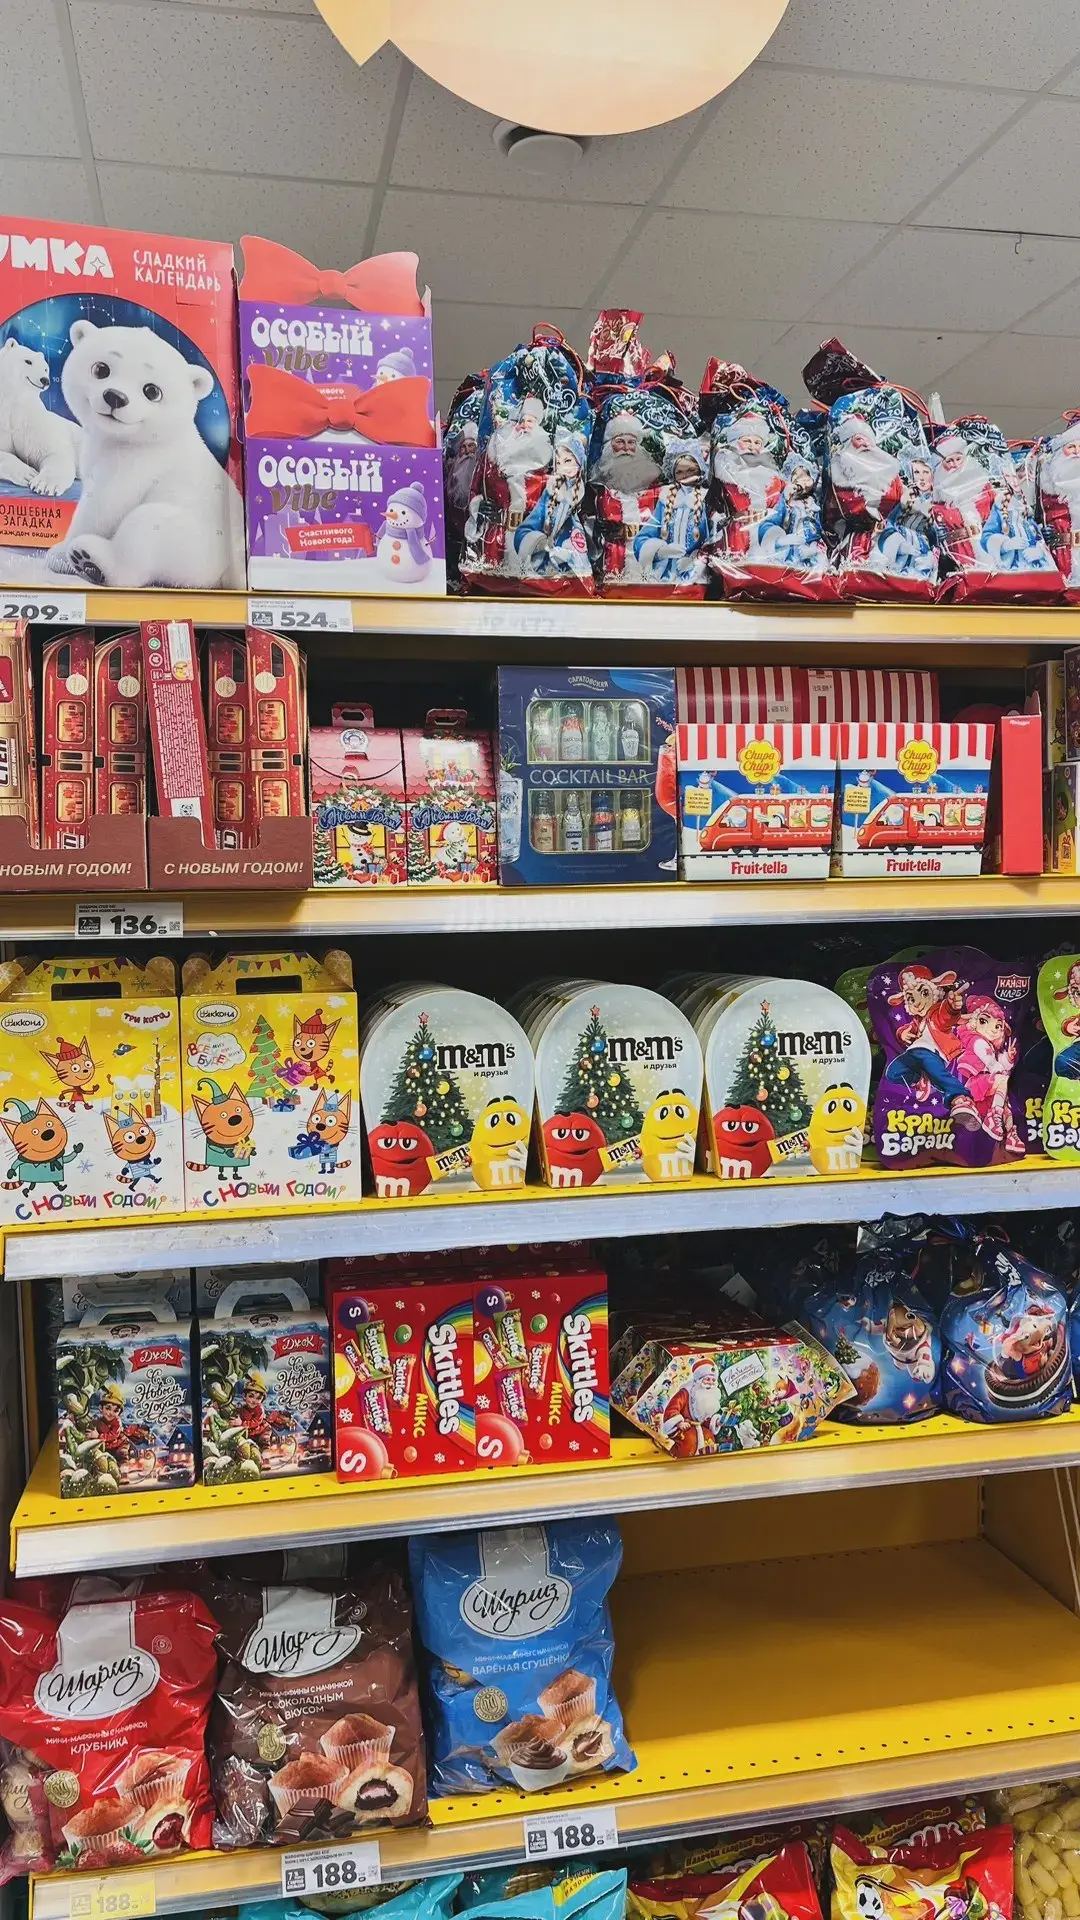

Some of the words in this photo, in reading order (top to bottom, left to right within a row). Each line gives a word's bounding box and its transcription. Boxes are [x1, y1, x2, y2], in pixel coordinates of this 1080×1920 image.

[133, 249, 207, 273] СЛАДКИЙ
[134, 267, 221, 292] КАЛЕНДАРЬ
[251, 316, 374, 357] ОСОБЫЙ
[258, 452, 383, 493] ОСОБЫЙ
[269, 483, 339, 513] Vibe
[0, 504, 62, 519] ОЛШЕБНАЯ
[3, 515, 52, 529] ЗАГАДКА
[32, 531, 59, 539] окошке
[298, 527, 353, 538] Счастливого
[300, 537, 332, 547] Нового
[332, 535, 355, 545] года!
[3, 604, 59, 620] 209
[280, 611, 329, 628] 524
[744, 749, 775, 761] Chupa
[903, 749, 933, 760] Chupa
[529, 769, 615, 785] COCKTAIL
[618, 768, 650, 785] BAR
[742, 759, 775, 777] Chups
[901, 759, 932, 776] Chups
[0, 863, 63, 876] НОВЫМ
[66, 862, 132, 875] ГОДОМ!
[164, 863, 176, 874] С
[178, 862, 240, 874] НОВЫМ
[243, 862, 304, 874] ГОДОМ!
[731, 861, 788, 874] Fruit-tella
[886, 858, 941, 872] Fruit-tella
[110, 915, 158, 934] 136
[124, 1012, 140, 1024] ТРИ
[142, 1011, 170, 1024] КОТА
[650, 1062, 677, 1071] друзья
[818, 1056, 846, 1065] друзья
[480, 1070, 509, 1078] друзья
[887, 1109, 954, 1136] КРАШ
[550, 1165, 583, 1188] m
[720, 1157, 752, 1179] m
[203, 1190, 219, 1207] С
[219, 1182, 280, 1202] НОВЫМ
[376, 1175, 410, 1198] m
[15, 1203, 32, 1220] С
[32, 1194, 96, 1215] НОВЫМ
[282, 1336, 315, 1350] Джек
[140, 1349, 174, 1363] Джек
[529, 1347, 543, 1389] Skittles
[563, 1312, 598, 1423] Skittles
[393, 1358, 407, 1401] Skittles
[428, 1323, 464, 1435] Skittles
[502, 1376, 520, 1418] Skittles
[548, 1381, 563, 1426] МИКС
[365, 1389, 384, 1432] Skittles
[413, 1392, 428, 1439] МИКС
[477, 1435, 504, 1459] S
[339, 1449, 367, 1473] S
[473, 1583, 559, 1633] Шарлиз
[48, 1655, 144, 1712] Шарлиз
[315, 1678, 353, 1691] НАЧИНКОЙ
[285, 1705, 324, 1720] ВКУСОМ
[70, 1737, 128, 1755] КЛУБНИКА
[553, 1823, 596, 1850] 188
[288, 1872, 292, 1880] 7
[312, 1860, 358, 1887] 188
[97, 1893, 130, 1913] 188
